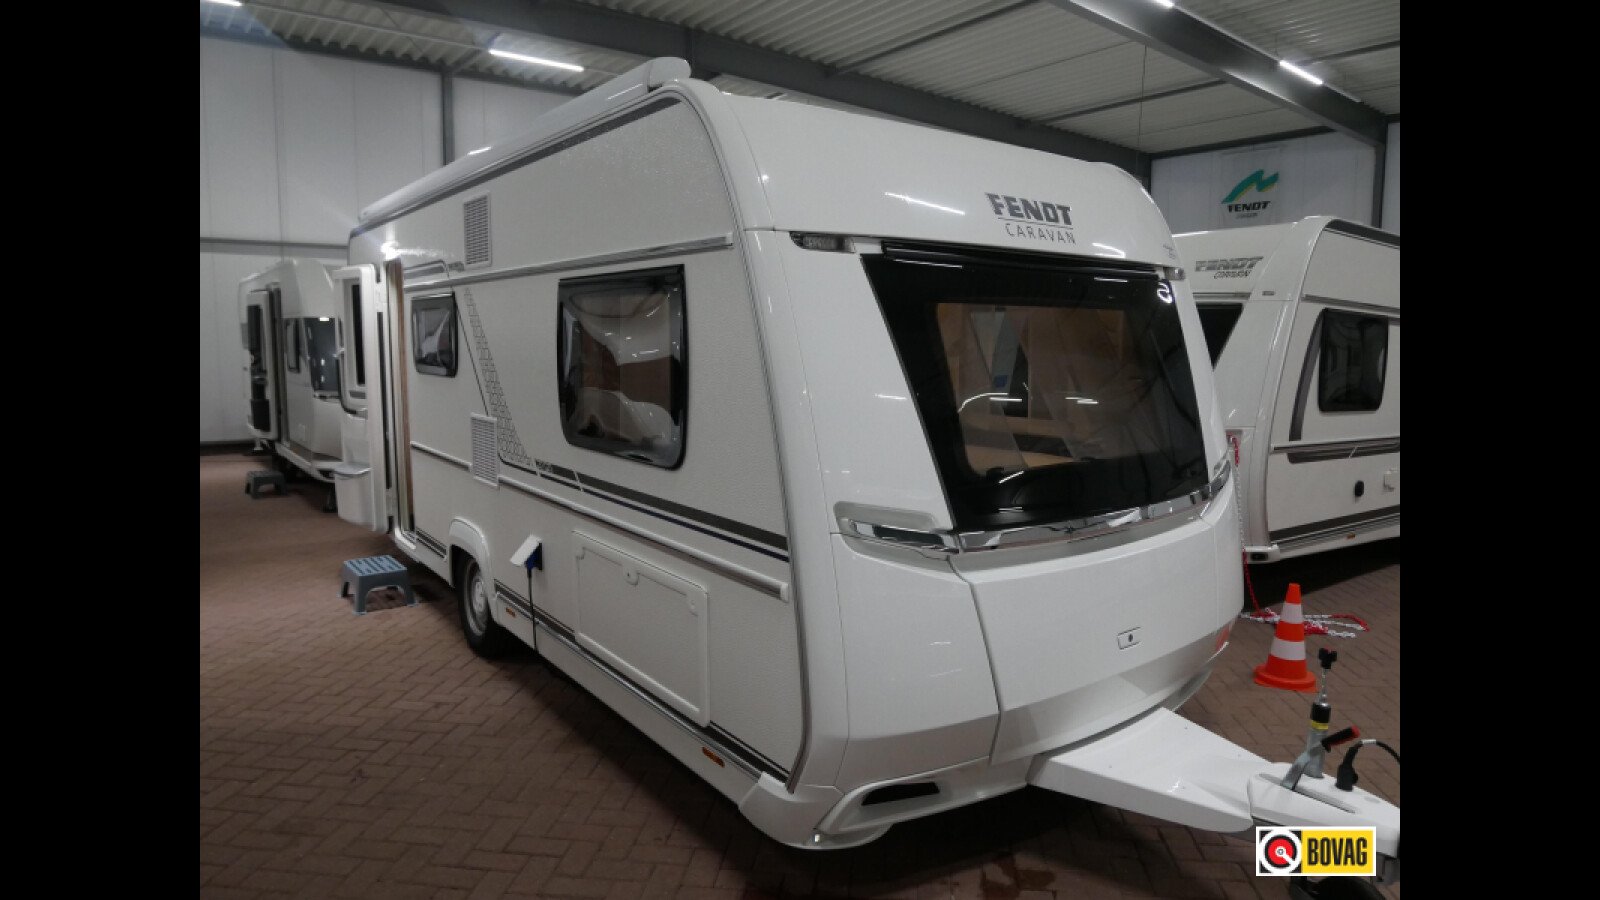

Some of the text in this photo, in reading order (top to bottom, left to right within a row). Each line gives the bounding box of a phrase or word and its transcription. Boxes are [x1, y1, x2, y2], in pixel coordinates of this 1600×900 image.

[985, 192, 1073, 225] FENDT
[1227, 200, 1271, 213] FENDT
[1005, 222, 1077, 245] CARAVAN
[1195, 256, 1264, 272] FENDT
